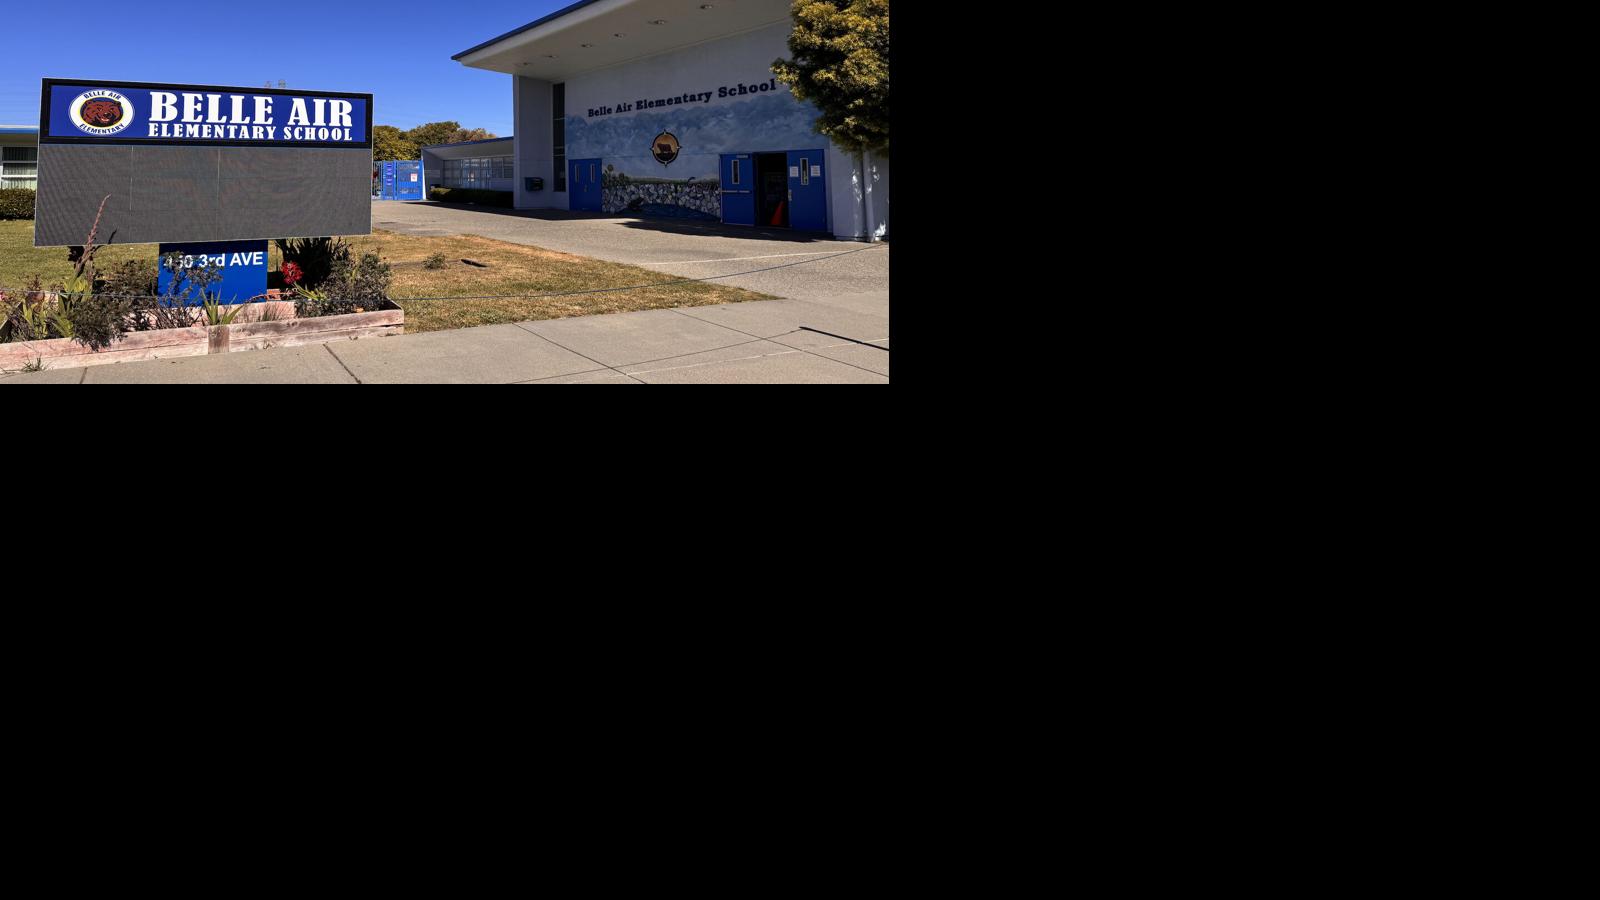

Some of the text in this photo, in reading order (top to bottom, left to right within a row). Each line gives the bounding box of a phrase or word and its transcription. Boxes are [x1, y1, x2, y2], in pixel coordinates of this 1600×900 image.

[83, 91, 122, 100] BELLE AIR
[588, 78, 776, 117] Belle Air Elementary School
[149, 91, 353, 127] BELLE AIR
[79, 123, 125, 134] ELEMENTARY
[148, 122, 353, 141] ELEMENTARY SCHOOL
[199, 253, 226, 267] 3rd
[229, 251, 264, 266] AVE
